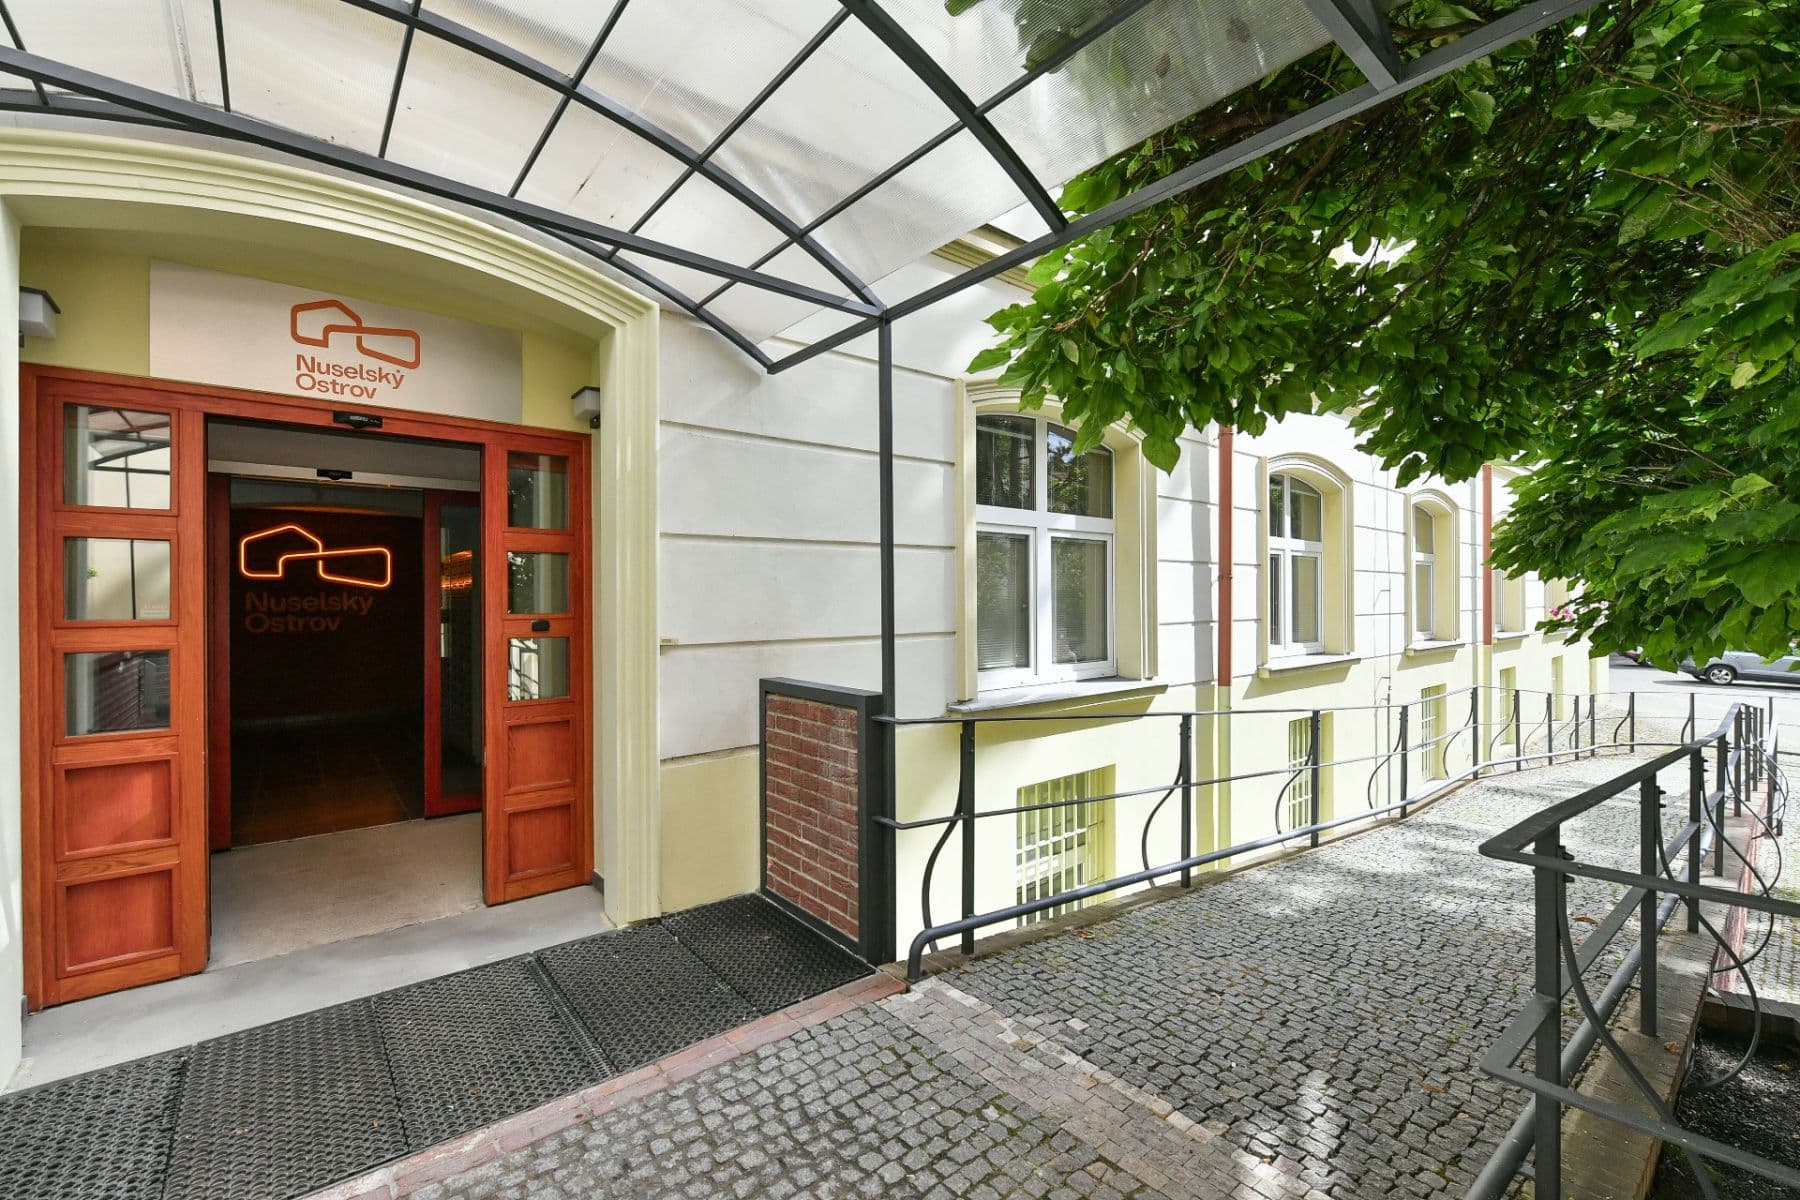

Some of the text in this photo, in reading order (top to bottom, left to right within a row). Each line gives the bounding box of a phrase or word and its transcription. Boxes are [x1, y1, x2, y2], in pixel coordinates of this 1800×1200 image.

[296, 353, 405, 390] Nuselský
[296, 373, 377, 399] Ostrov
[244, 613, 343, 633] Ostrov
